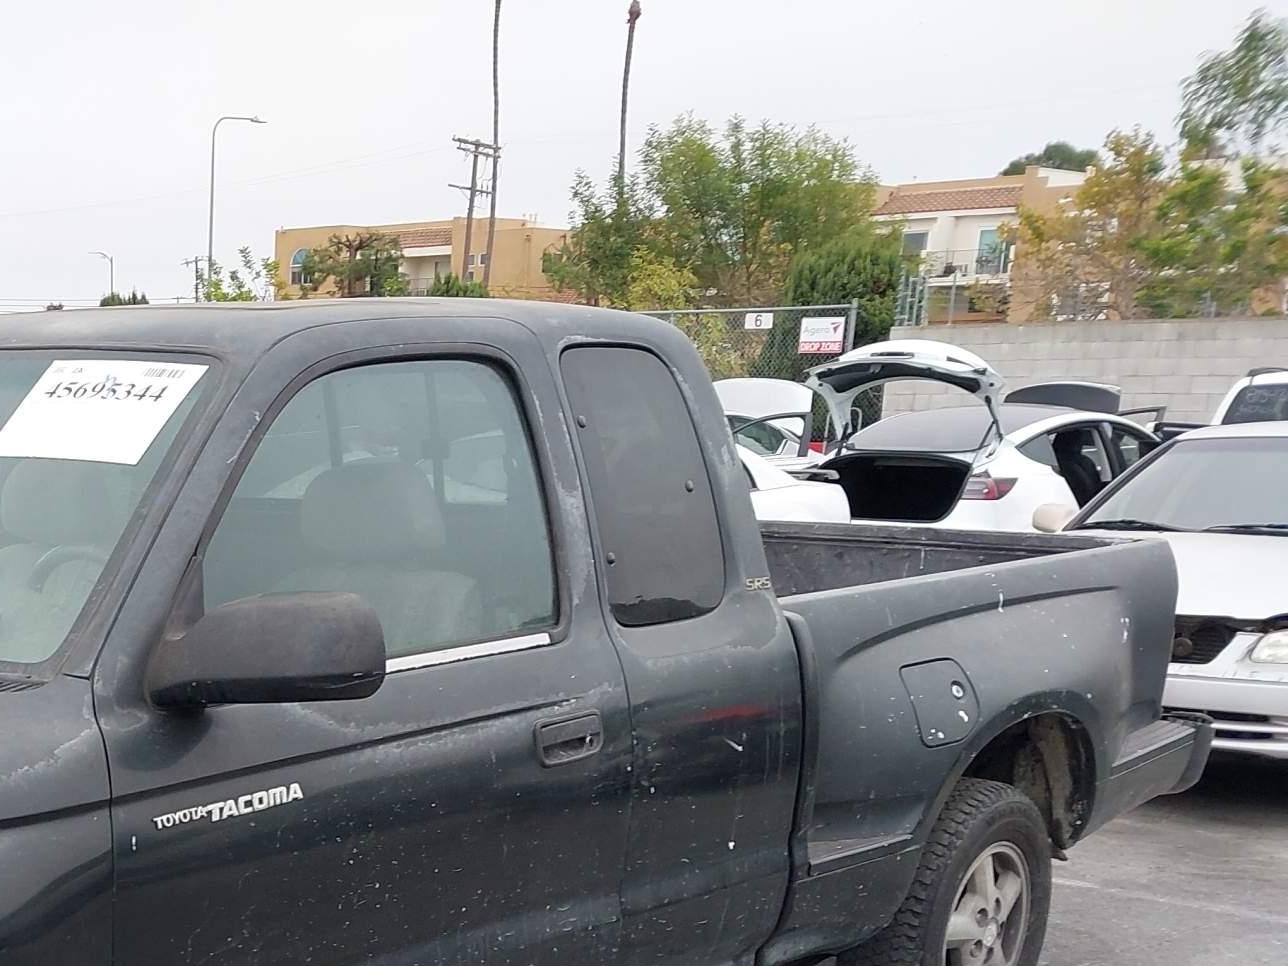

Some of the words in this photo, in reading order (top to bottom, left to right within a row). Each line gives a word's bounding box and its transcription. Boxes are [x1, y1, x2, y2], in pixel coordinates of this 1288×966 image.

[755, 314, 762, 327] 6
[800, 342, 820, 352] DROP
[820, 342, 841, 352] ZONE
[44, 381, 169, 402] 45695344
[153, 806, 209, 830] TOYOTA
[206, 782, 304, 822] TACOMA
